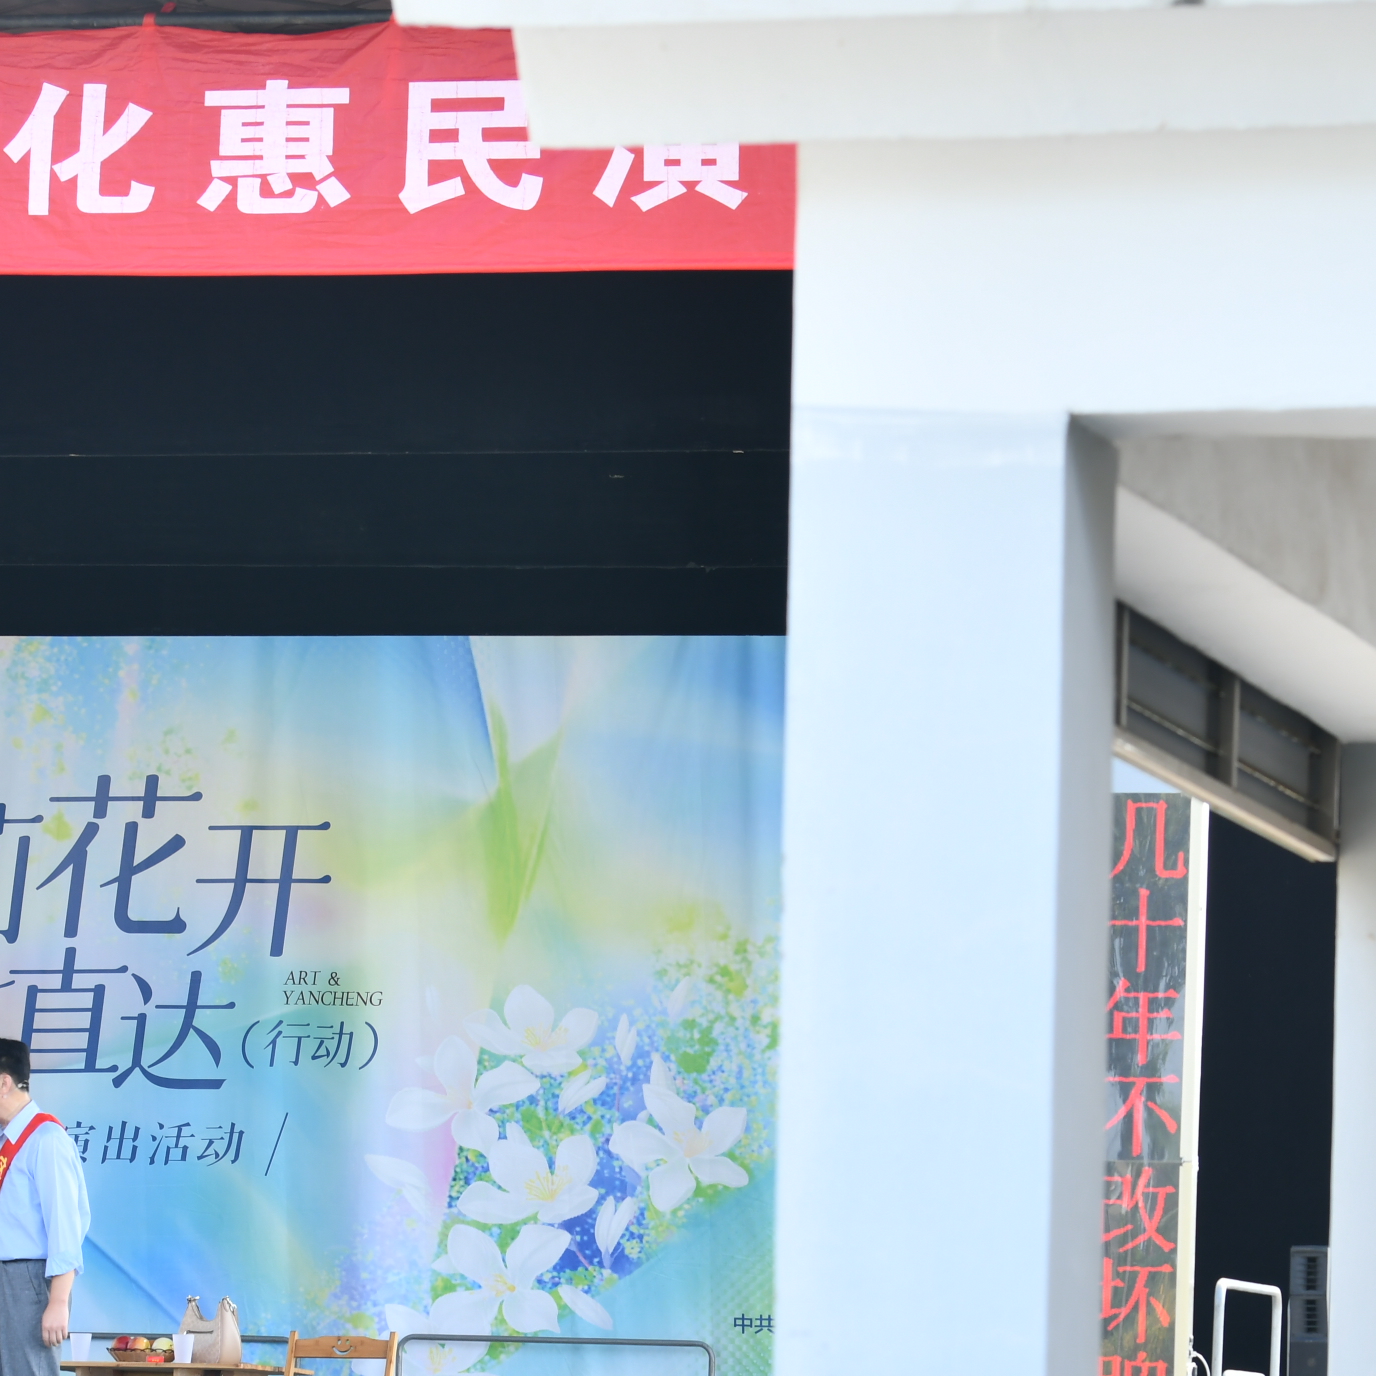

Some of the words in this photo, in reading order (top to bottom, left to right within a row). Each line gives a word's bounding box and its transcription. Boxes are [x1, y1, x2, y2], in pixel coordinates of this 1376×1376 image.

[283, 970, 321, 986] ART
[327, 971, 341, 987] &
[282, 990, 384, 1007] YANCHENG
[734, 1313, 776, 1334] 中共
